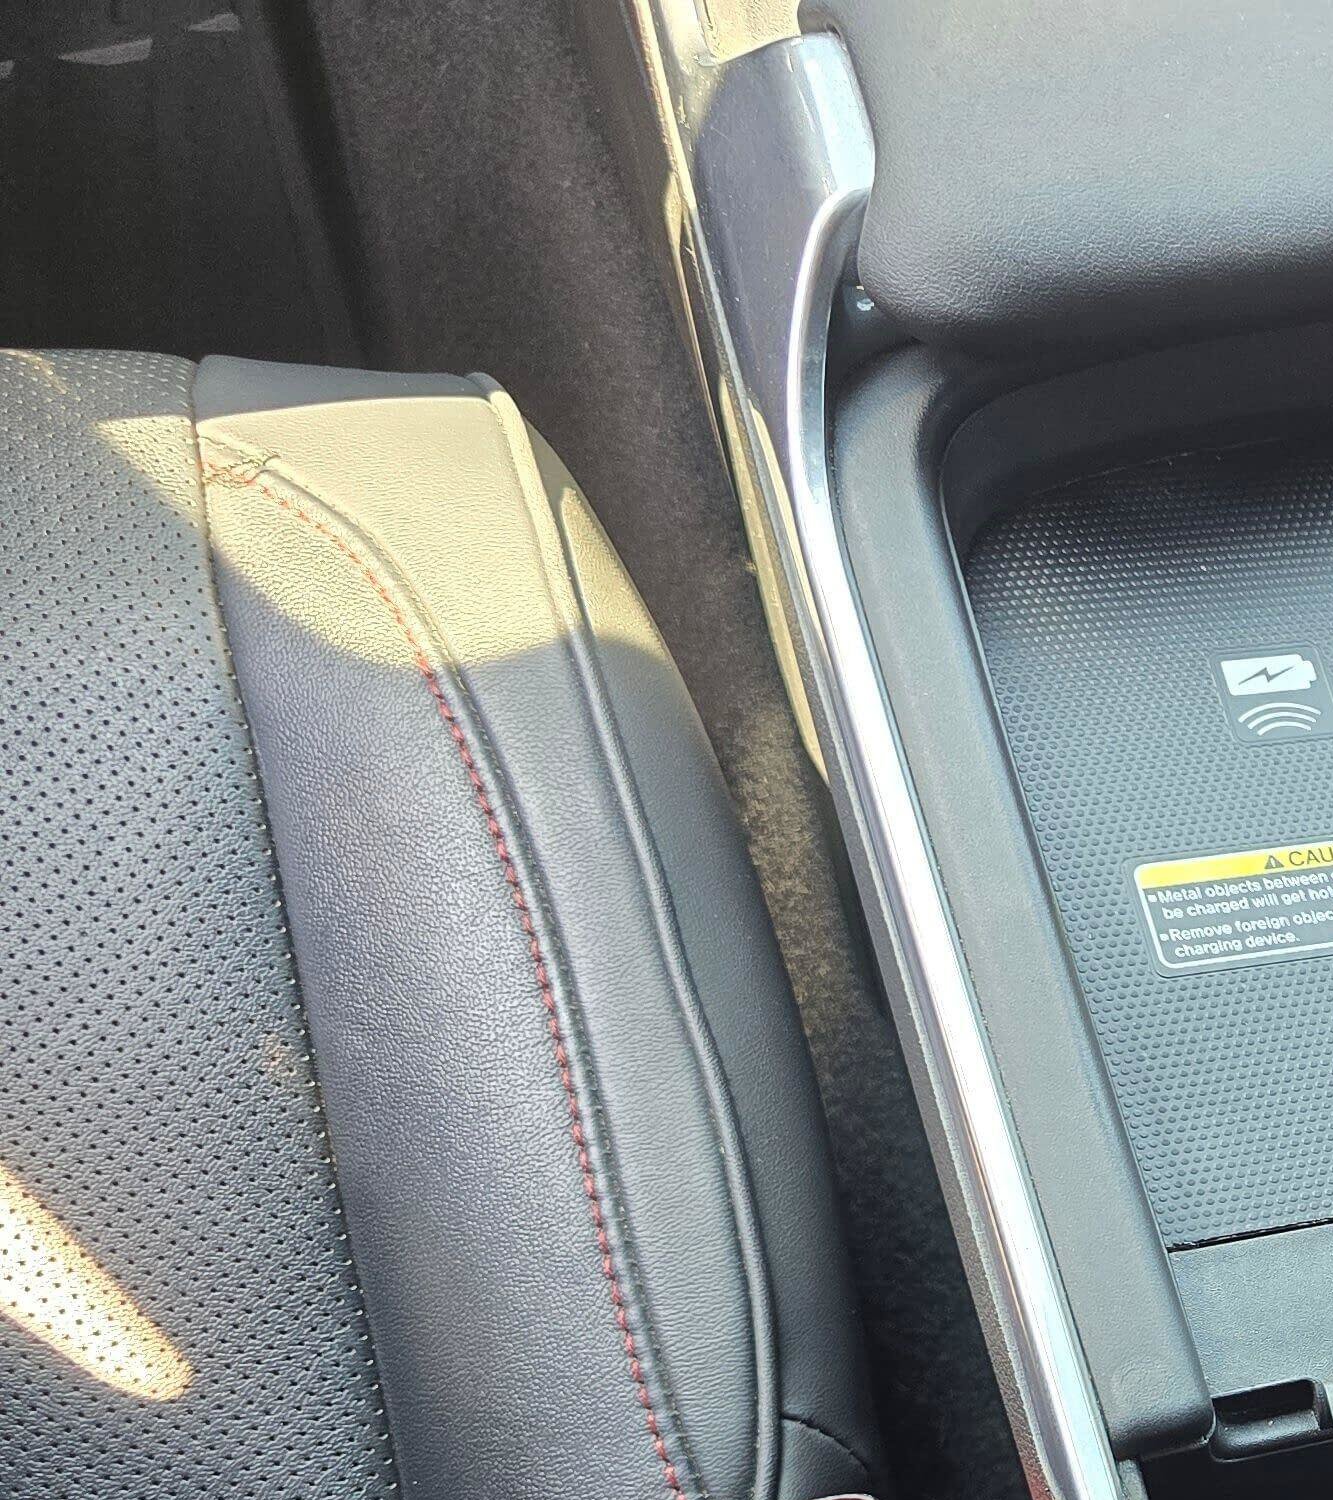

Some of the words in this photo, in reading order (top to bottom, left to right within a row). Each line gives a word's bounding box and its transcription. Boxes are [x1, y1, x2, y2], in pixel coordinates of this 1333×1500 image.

[1158, 886, 1202, 904] Metal
[1205, 880, 1261, 900] objects
[1264, 870, 1329, 891] between
[1162, 905, 1184, 920] be
[1187, 897, 1249, 917] charged
[1253, 892, 1279, 908] will
[1281, 889, 1307, 906] get
[1169, 923, 1233, 942] Remove
[1234, 915, 1291, 936] foreign
[1174, 937, 1243, 958] charging
[1246, 930, 1301, 950] device.
